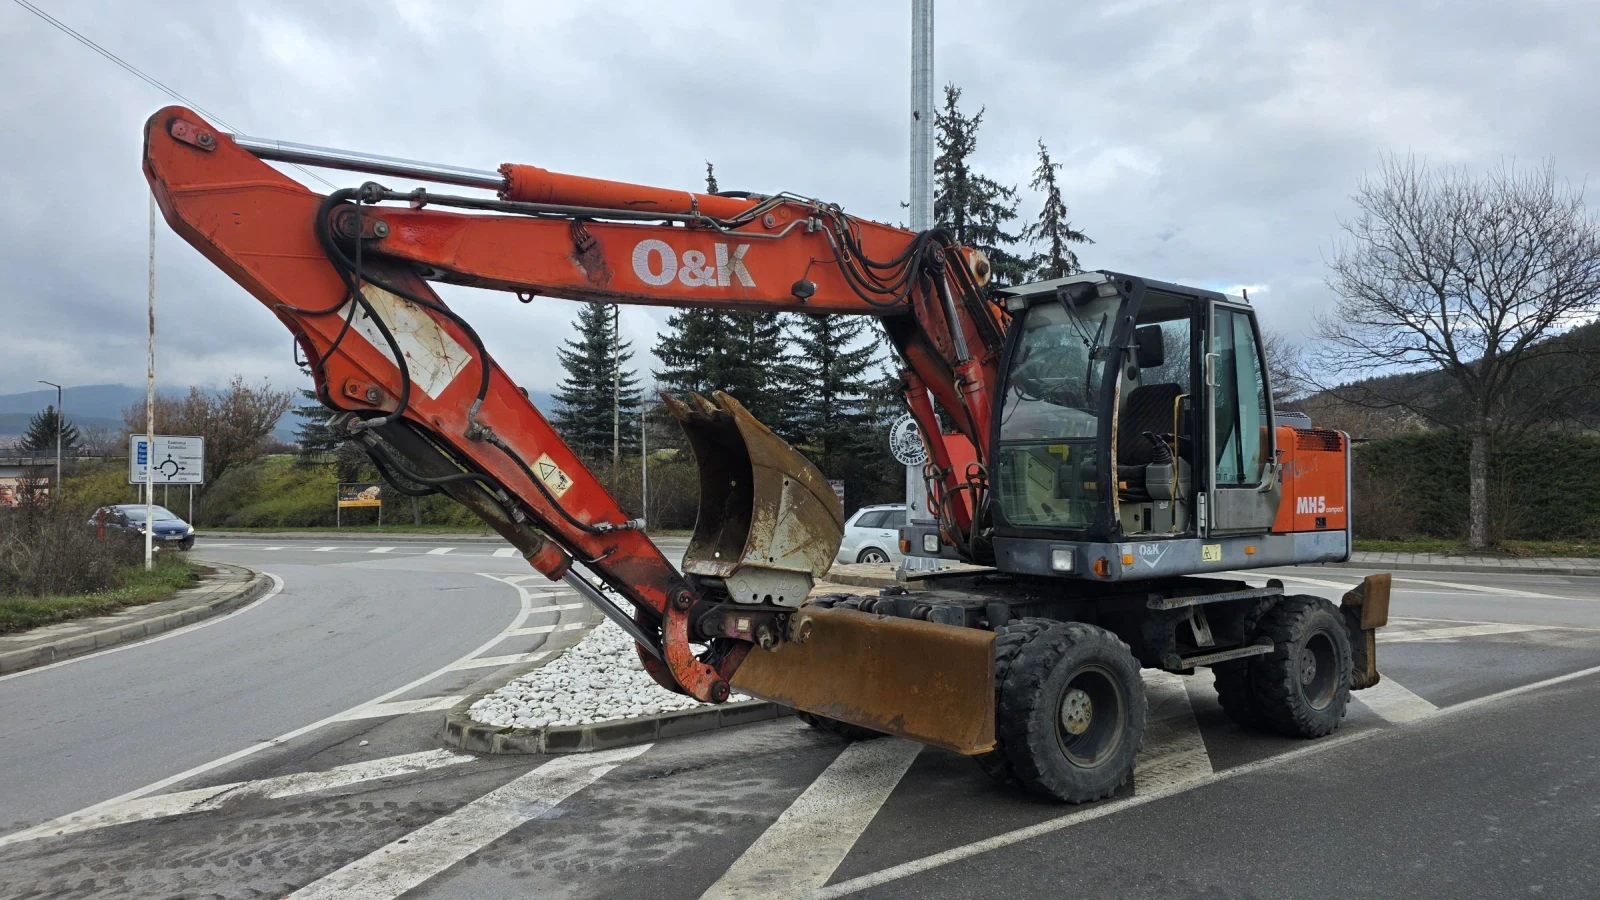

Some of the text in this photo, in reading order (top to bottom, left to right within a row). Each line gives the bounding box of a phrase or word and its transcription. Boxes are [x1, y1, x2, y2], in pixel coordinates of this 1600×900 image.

[632, 239, 756, 287] O&K
[898, 452, 927, 463] BULGARIA
[1296, 496, 1344, 514] MH5 compact
[1139, 544, 1160, 555] O&K
